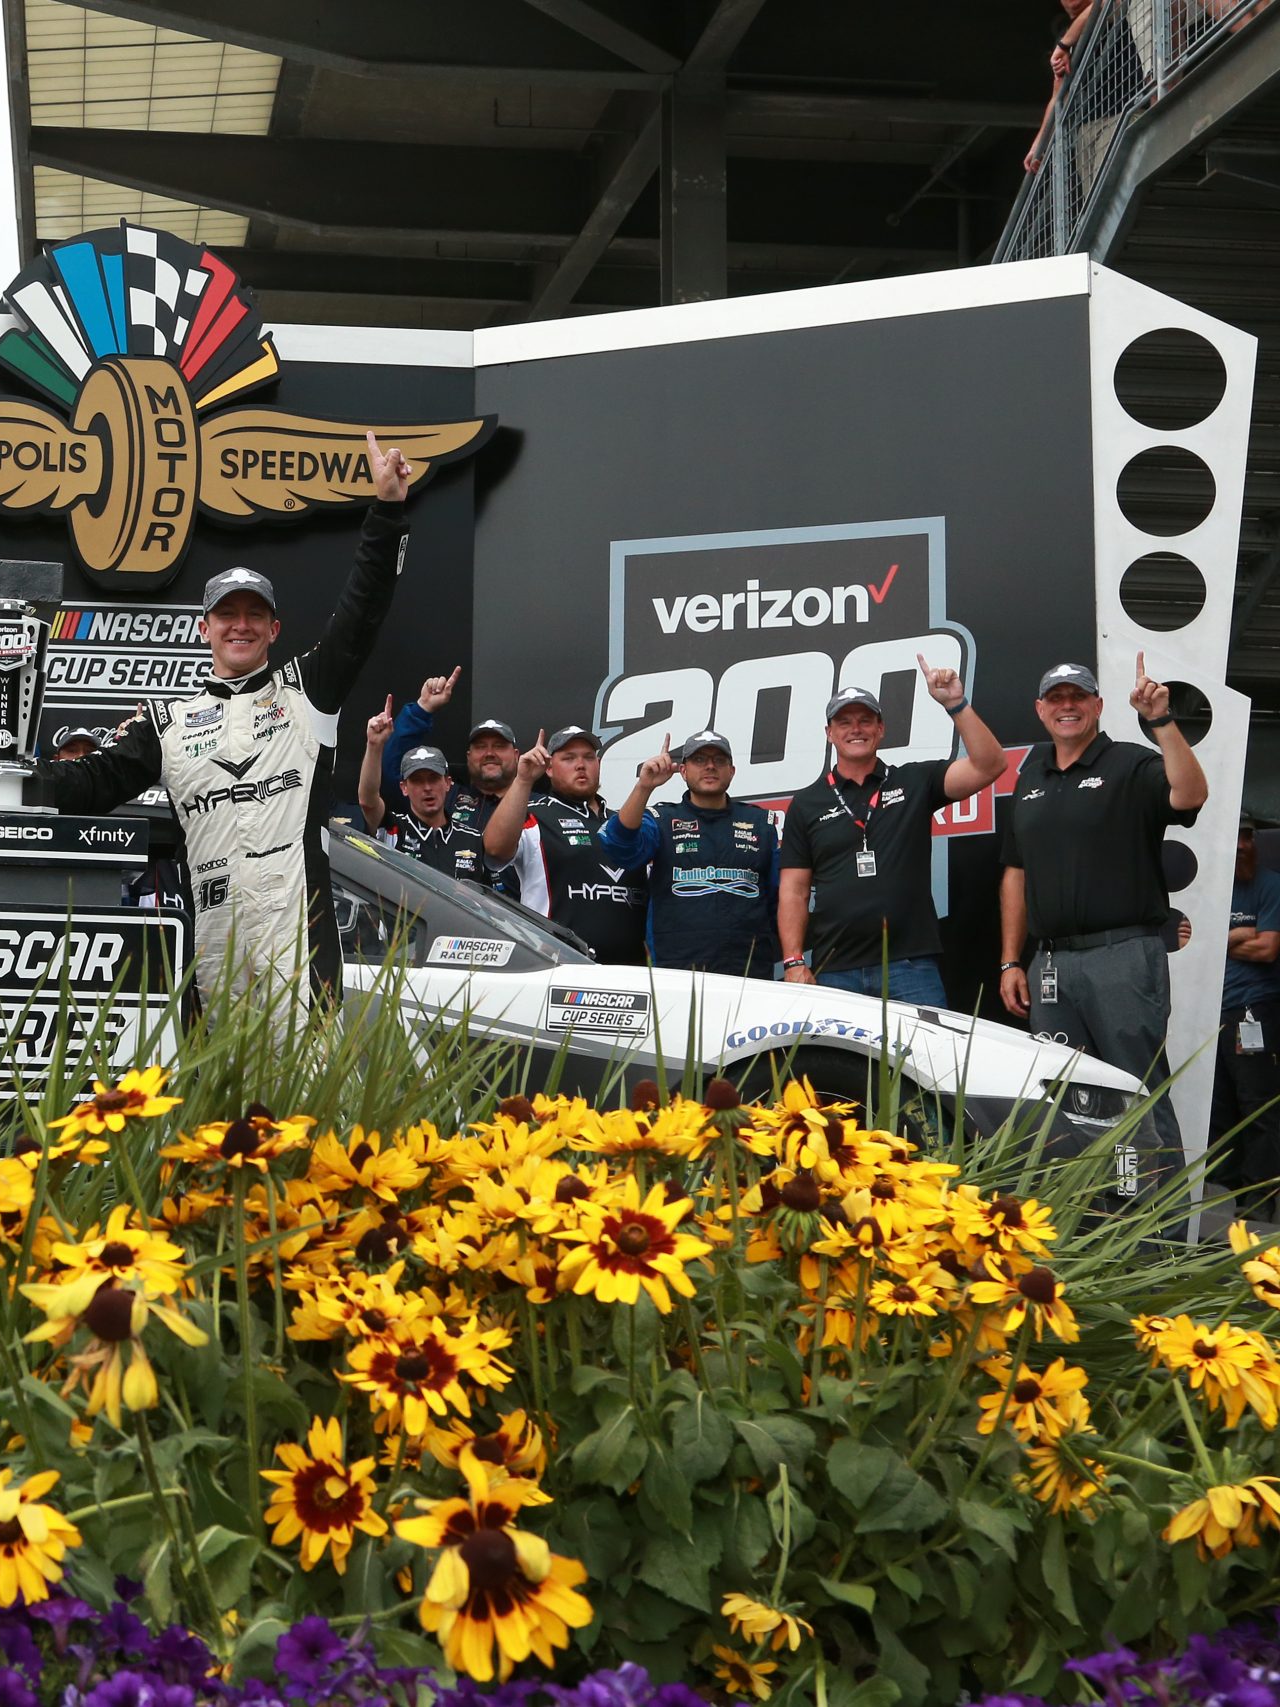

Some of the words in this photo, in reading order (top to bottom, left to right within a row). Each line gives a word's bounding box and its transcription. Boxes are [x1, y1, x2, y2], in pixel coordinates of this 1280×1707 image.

[140, 384, 188, 553] MOTOR
[220, 447, 373, 485] SPEEDWA
[651, 578, 870, 634] verizon
[47, 656, 107, 687] CUP
[111, 656, 217, 689] SERIES
[0, 677, 10, 726] WINNER
[599, 633, 962, 807] 200
[199, 738, 218, 751] LHS
[181, 768, 303, 820] HYPERICE
[78, 826, 136, 847] xfinity
[196, 857, 228, 874] sparco
[199, 874, 231, 914] 16
[567, 882, 635, 909] HYPER
[440, 951, 471, 961] RACE
[473, 952, 499, 962] CAR
[457, 941, 504, 953] NASCAR
[579, 991, 635, 1008] NASCAR
[561, 1010, 587, 1022] CUP
[588, 1012, 635, 1027] SERIES
